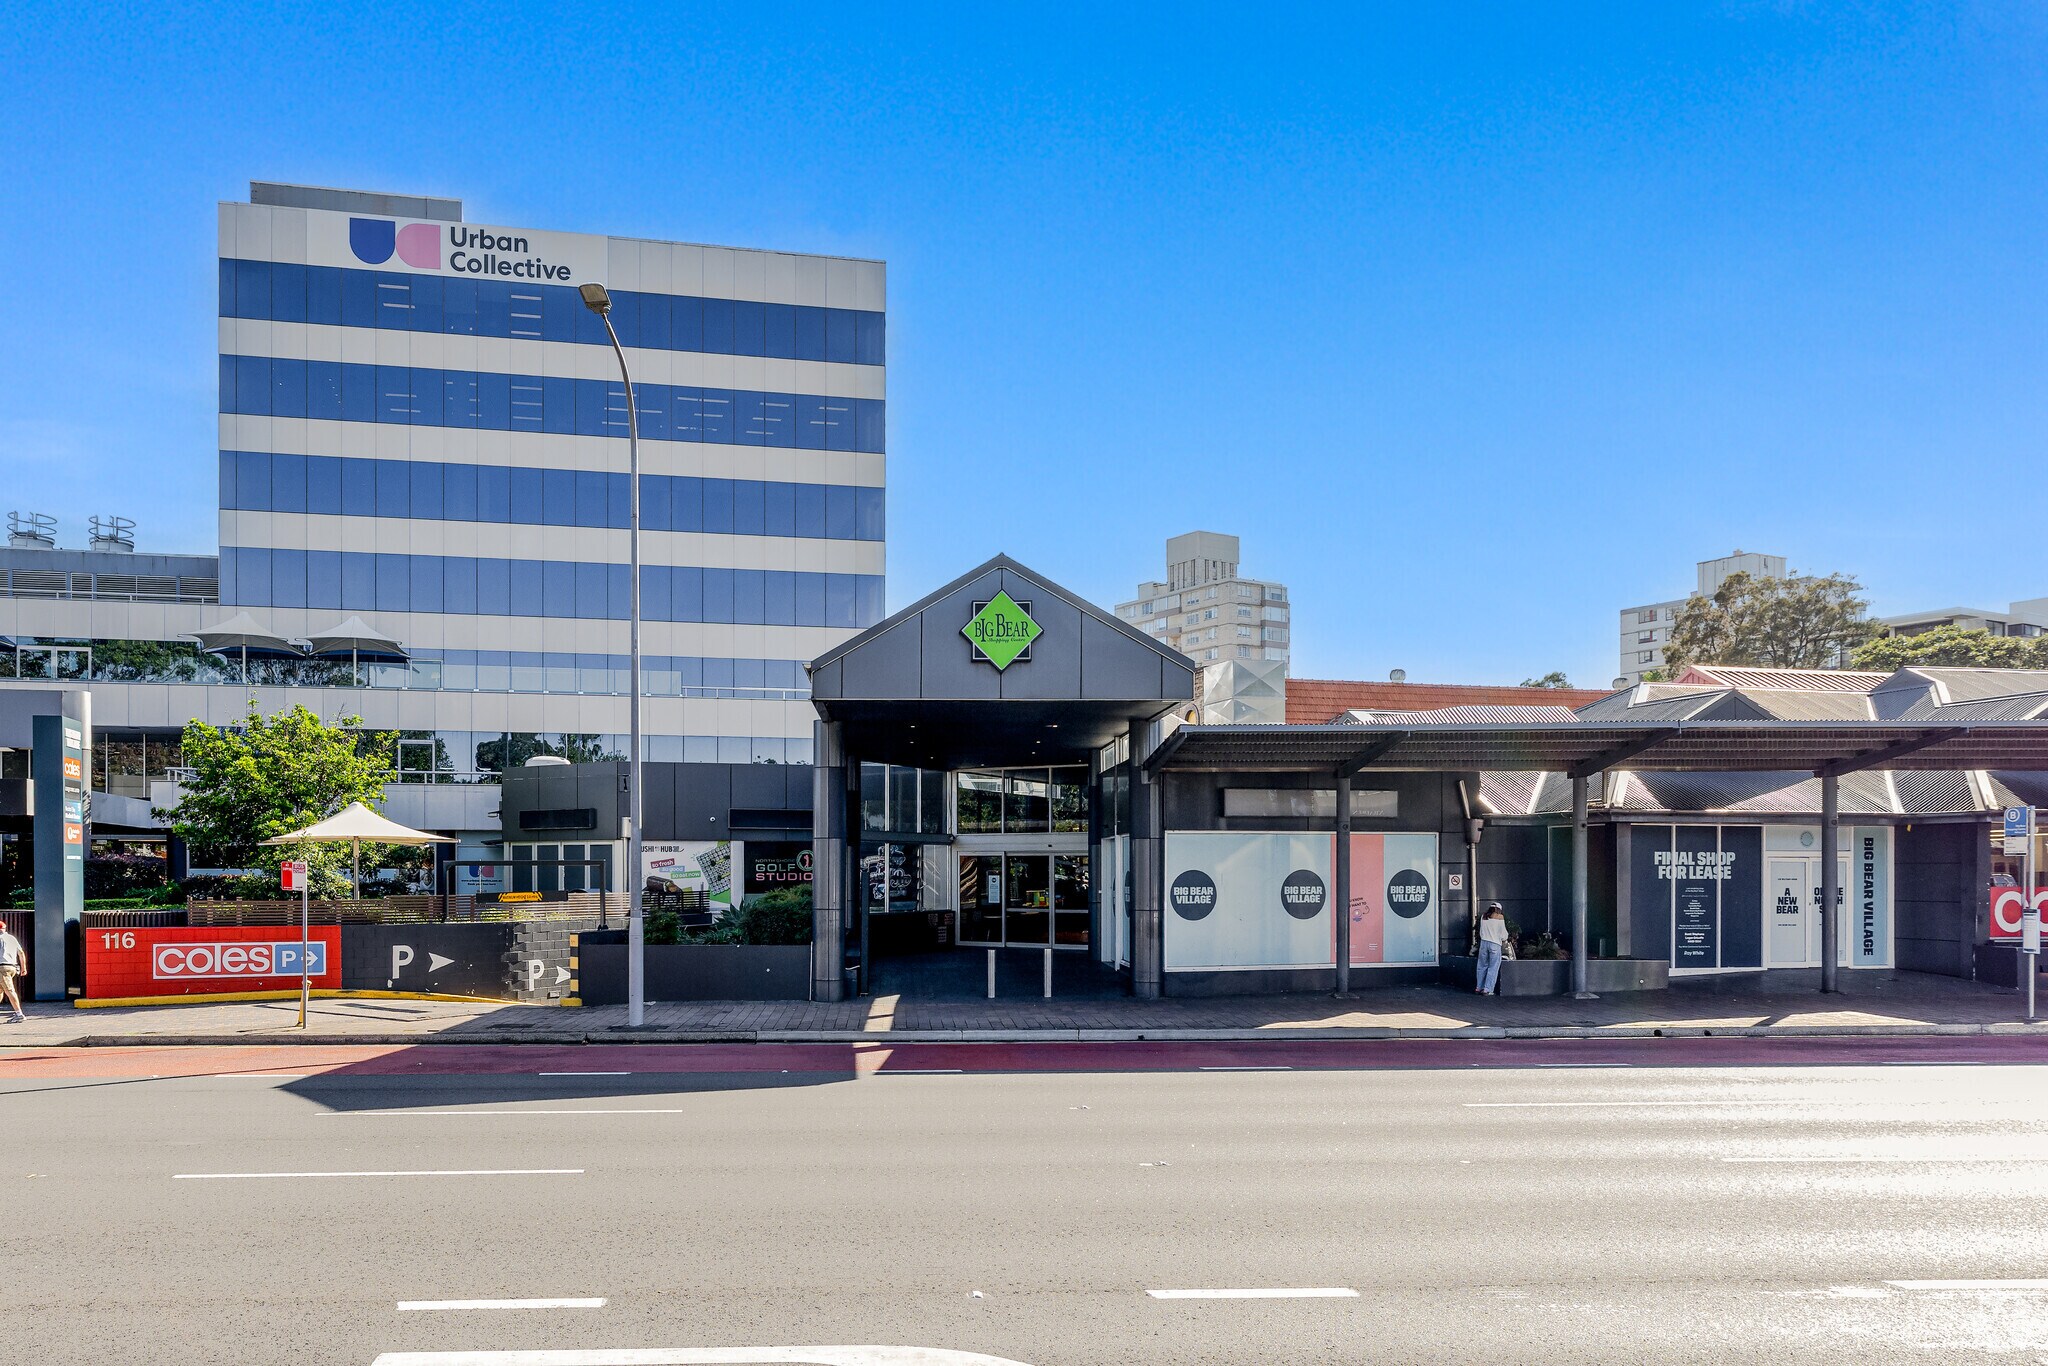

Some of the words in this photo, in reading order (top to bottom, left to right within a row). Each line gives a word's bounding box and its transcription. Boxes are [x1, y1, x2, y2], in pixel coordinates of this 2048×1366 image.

[450, 226, 529, 253] Urban
[449, 251, 571, 281] Collective
[974, 618, 994, 642] BIG
[995, 613, 1030, 637] BEAR
[64, 760, 81, 777] coles
[2009, 811, 2017, 819] B
[641, 845, 654, 857] USHI
[1863, 837, 1874, 861] BIG
[1654, 851, 1696, 865] FINAL
[1697, 851, 1736, 866] SHOP
[755, 863, 796, 872] GOLF
[1658, 865, 1687, 880] FOR
[1689, 865, 1732, 880] LEASE
[1863, 862, 1874, 899] BEAR
[1173, 886, 1189, 896] BIG
[1190, 886, 1214, 896] BEAR
[1284, 886, 1299, 895] BIG
[1299, 886, 1323, 895] BEAR
[1390, 885, 1405, 894] BIG
[1405, 885, 1427, 894] BEAR
[1784, 887, 1791, 896] A
[1175, 895, 1212, 904] VILLAGE
[1286, 894, 1321, 903] VILLAGE
[1392, 893, 1425, 903] VILLAGE
[1777, 896, 1798, 905] NEW
[1776, 905, 1799, 914] BEAR
[1863, 901, 1874, 956] VILLAGE
[101, 931, 136, 950] 116
[157, 944, 271, 975] coles
[281, 950, 297, 968] P
[392, 944, 415, 980] P
[528, 959, 545, 992] P
